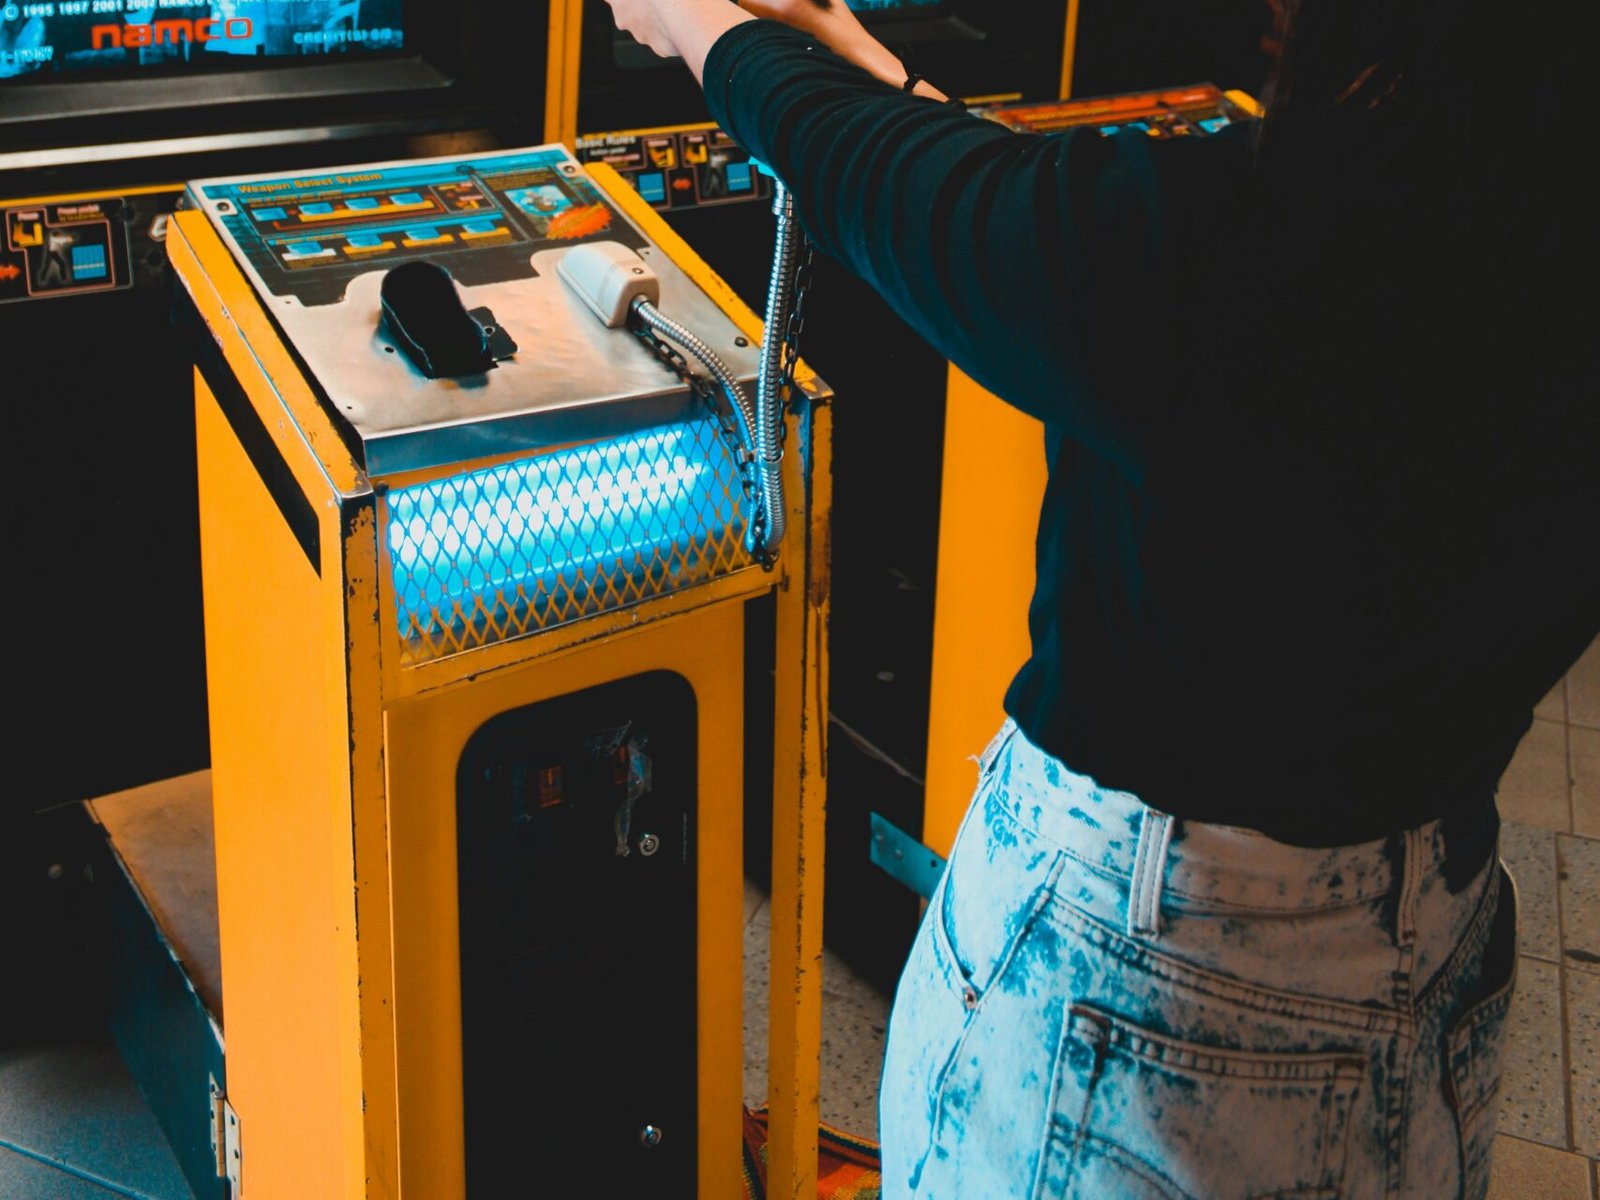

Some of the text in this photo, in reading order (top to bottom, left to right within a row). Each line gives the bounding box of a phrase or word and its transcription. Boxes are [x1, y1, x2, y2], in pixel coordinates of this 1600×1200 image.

[91, 18, 253, 50] namco
[238, 173, 382, 194] Weapon Select System
